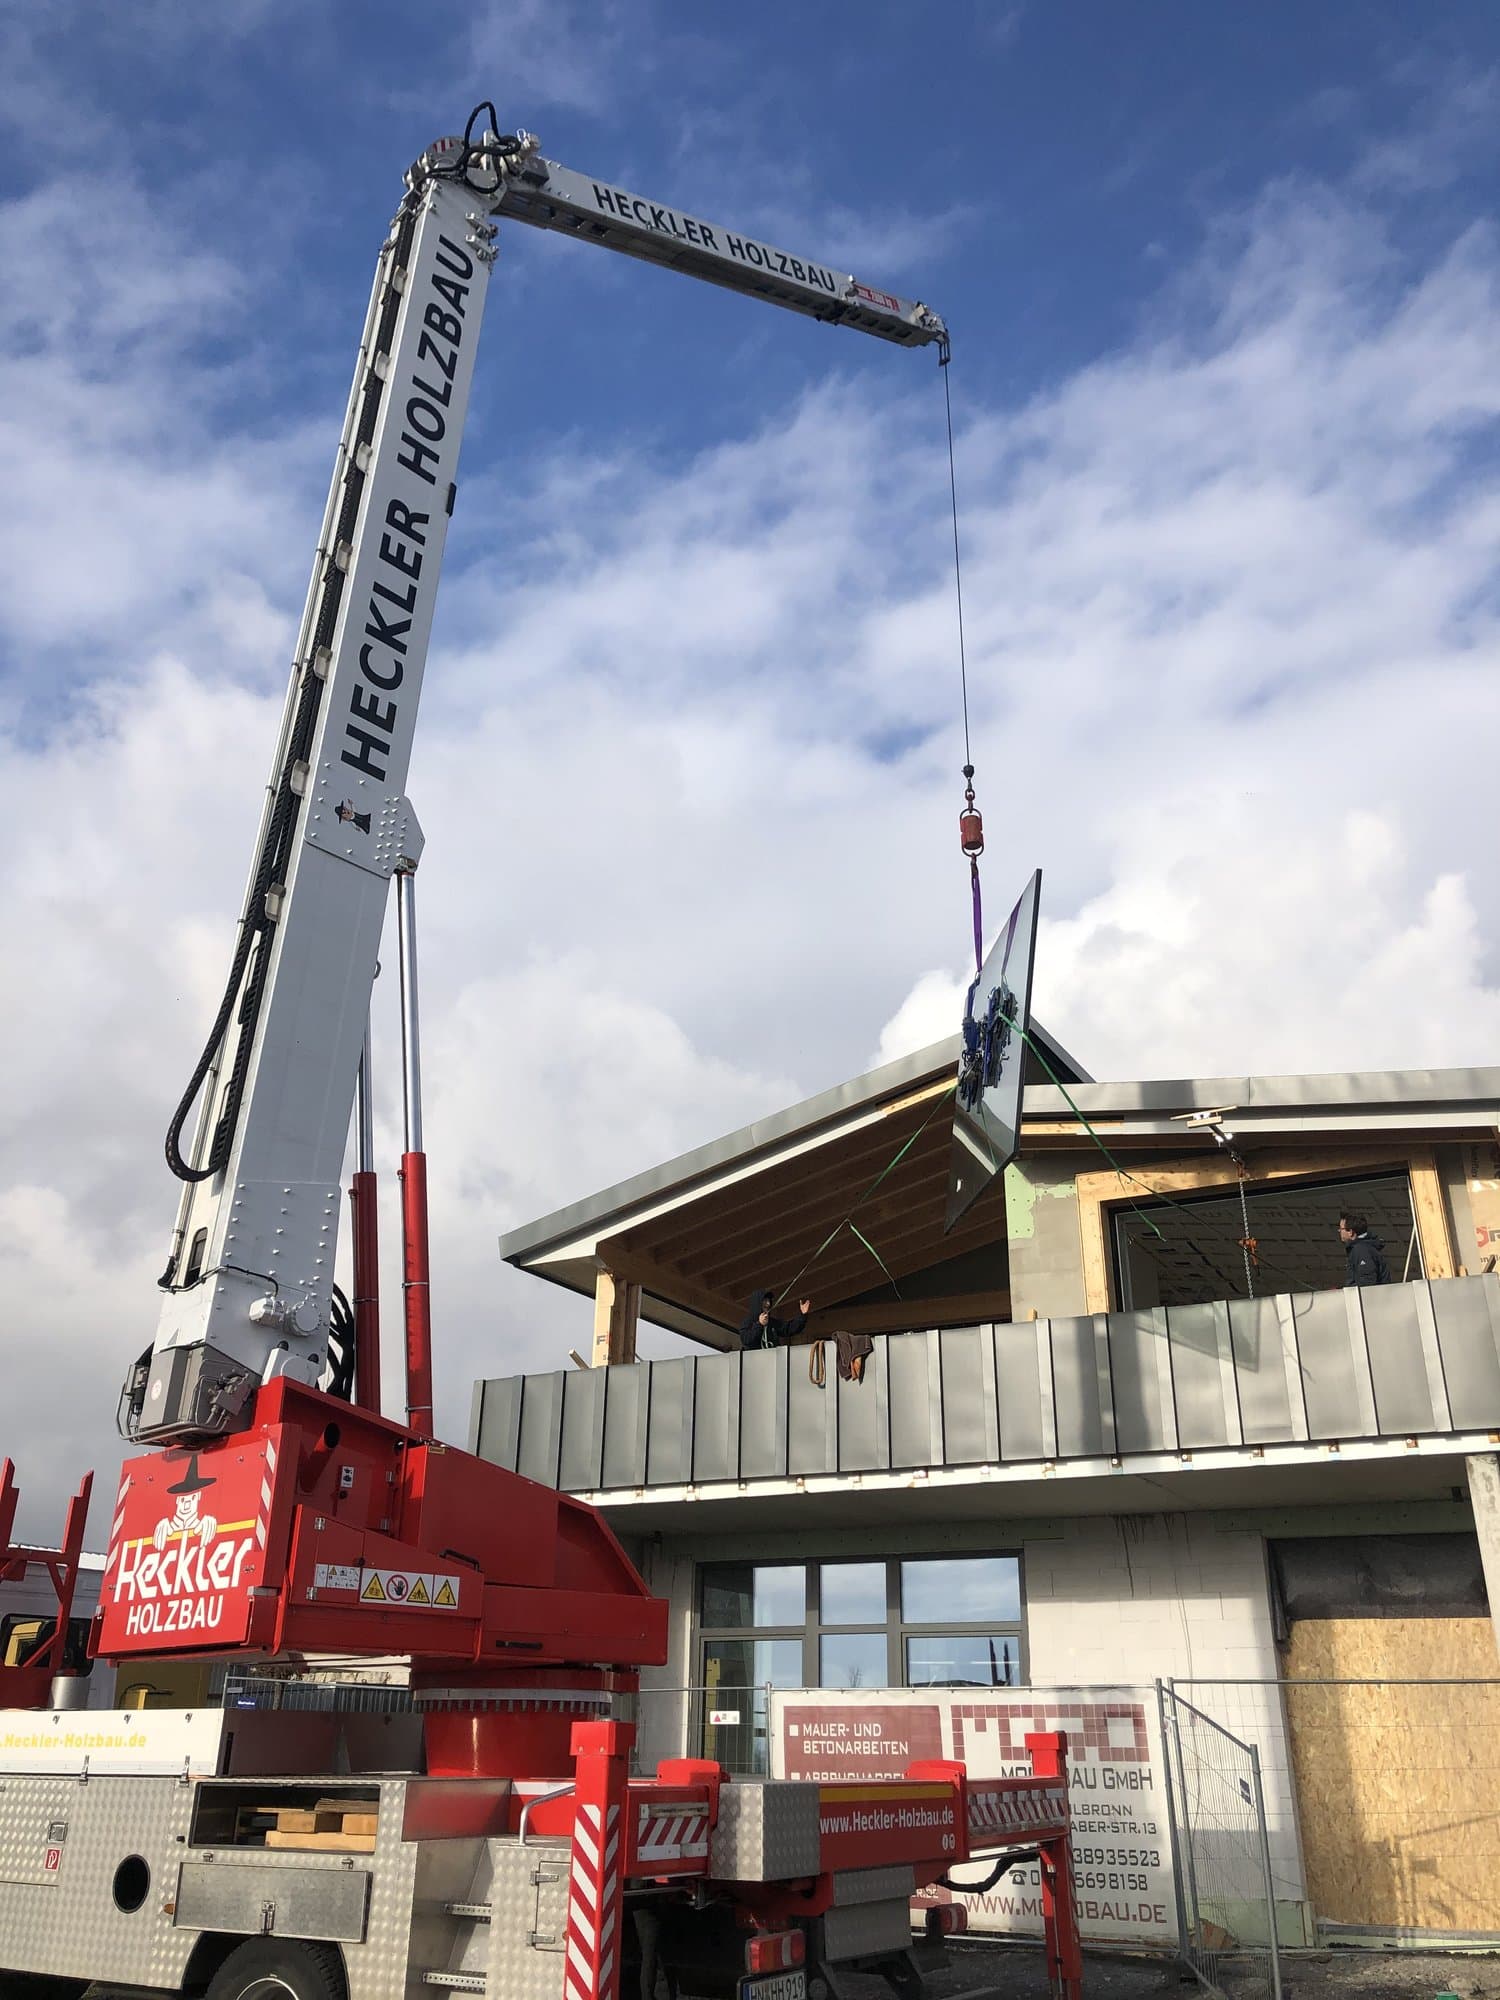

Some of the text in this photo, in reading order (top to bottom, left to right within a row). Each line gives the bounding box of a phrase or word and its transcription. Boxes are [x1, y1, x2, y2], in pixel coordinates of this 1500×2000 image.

[593, 184, 836, 293] HECKLER HOLZBAU
[340, 234, 474, 782] HECKLER HOLZBAU
[114, 1531, 253, 1603] Heckler
[126, 1595, 224, 1636] HOLZBAU
[803, 1723, 882, 1737] MAUER- UND
[803, 1741, 909, 1755] BETONARBEITEN
[820, 1805, 954, 1834] www.Heckler-Holzbau.de
